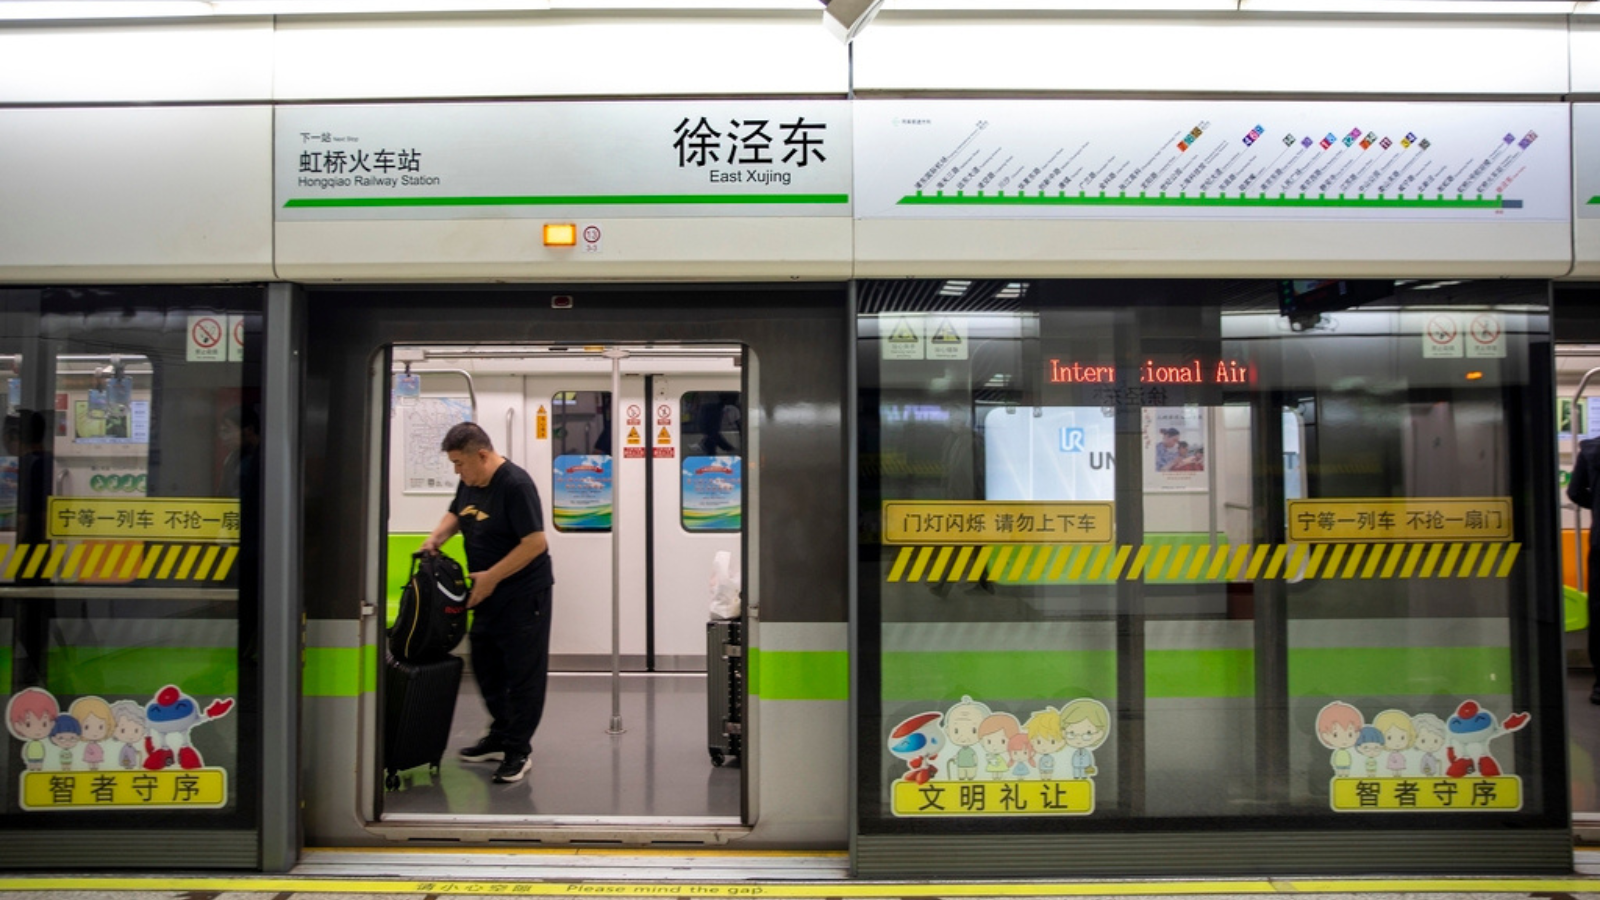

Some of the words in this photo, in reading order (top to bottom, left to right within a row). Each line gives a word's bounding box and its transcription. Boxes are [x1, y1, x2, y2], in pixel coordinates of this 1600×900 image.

[300, 132, 332, 143] 下一站
[673, 117, 827, 168] 徐泾东
[298, 148, 421, 174] 虹桥火车站
[298, 176, 351, 189] Hongqiao
[354, 175, 398, 188] Railway
[401, 174, 440, 186] Station
[710, 170, 742, 183] East
[746, 170, 791, 185] Xujing
[1050, 359, 1202, 383] Internional
[58, 508, 155, 530] 宁等一列车
[164, 509, 240, 531] 不抢一扇
[902, 513, 987, 533] 门灯闪烁
[994, 512, 1097, 532] 请勿上下车
[1297, 510, 1396, 532] 宁等一列车
[1405, 510, 1503, 530] 不抢一扇门
[49, 774, 202, 804] 智者守序
[917, 782, 1069, 811] 文明礼让
[1354, 780, 1499, 809] 智者守序
[566, 884, 626, 892] Please
[690, 886, 720, 894] the
